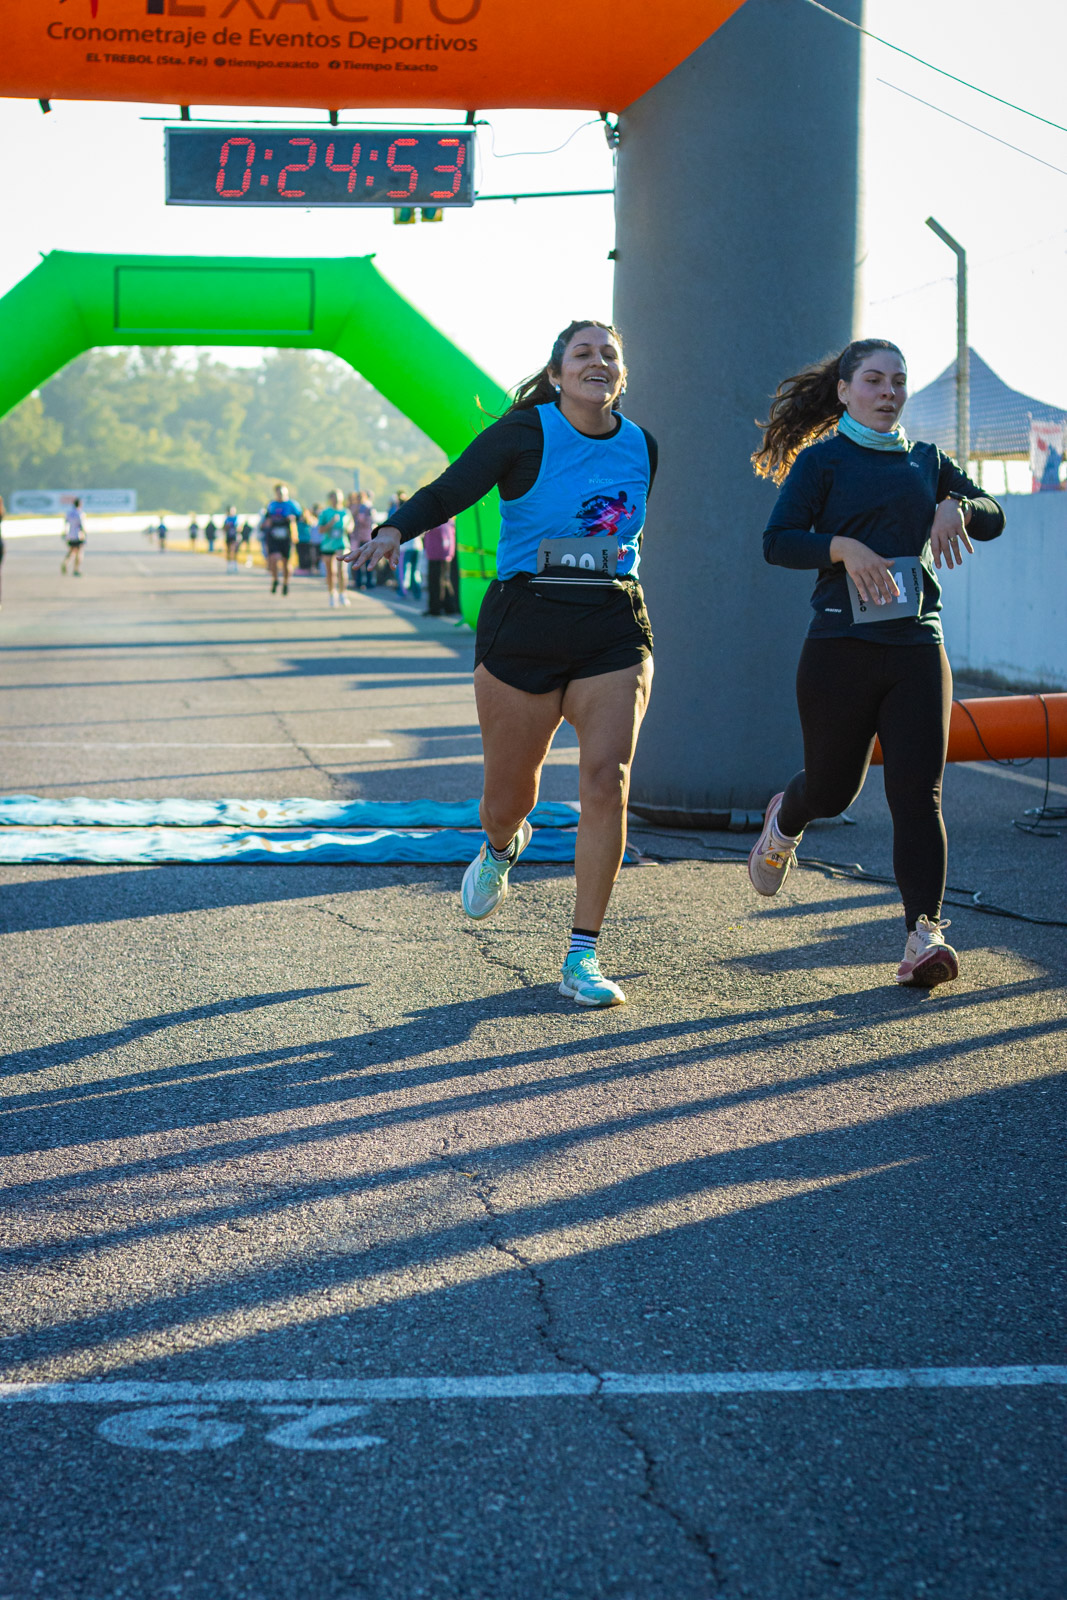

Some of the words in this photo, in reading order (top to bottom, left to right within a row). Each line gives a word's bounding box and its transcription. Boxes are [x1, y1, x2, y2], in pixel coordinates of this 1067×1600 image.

[47, 21, 207, 48] Cronometraje
[212, 27, 242, 46] de
[249, 28, 341, 48] Eventos
[348, 31, 478, 53] Deportivos
[86, 53, 102, 63] EL
[104, 53, 153, 64] TREBOL
[343, 61, 393, 72] Tiempo
[395, 62, 439, 73] Exacto
[215, 137, 465, 199] 0:24:53
